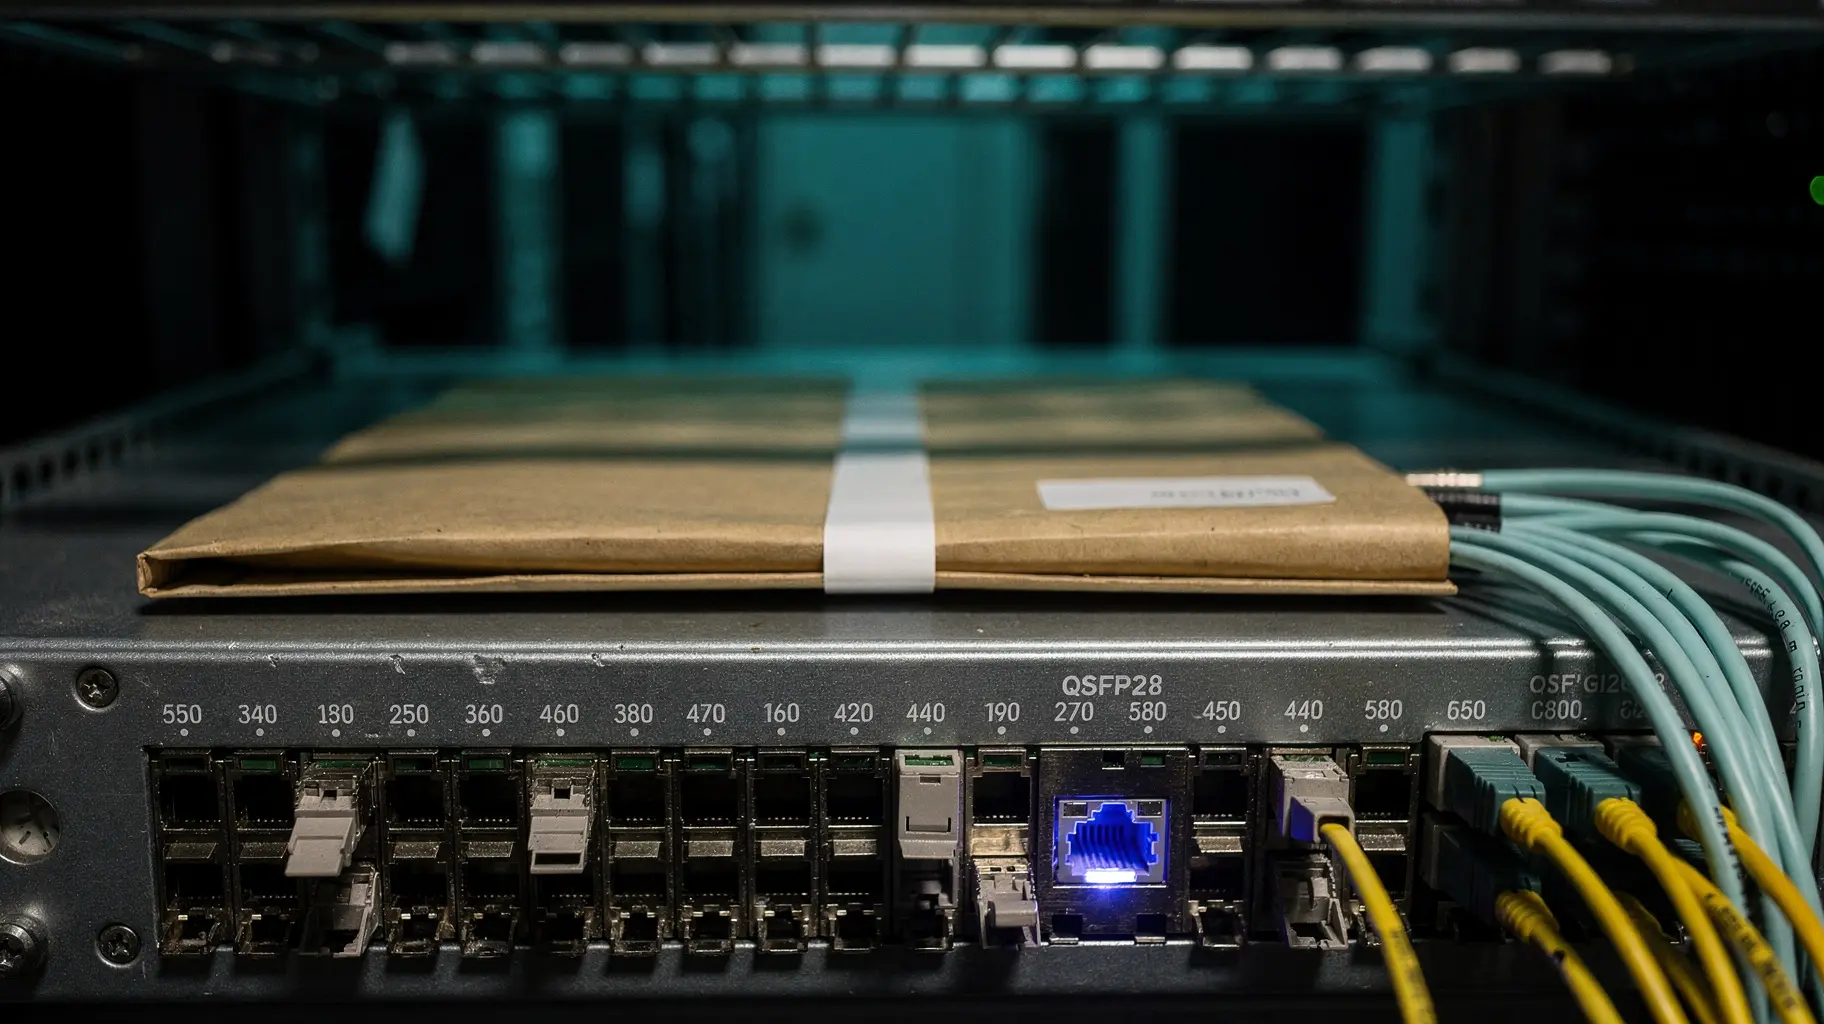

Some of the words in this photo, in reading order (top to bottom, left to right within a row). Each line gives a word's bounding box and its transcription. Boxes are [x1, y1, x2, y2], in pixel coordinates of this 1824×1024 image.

[1062, 674, 1163, 697] QSFP28
[162, 704, 202, 725] 550
[238, 704, 277, 725] 340
[317, 704, 354, 725] 180
[389, 704, 429, 725] 250
[465, 704, 504, 725] 360
[539, 704, 579, 724] 460
[613, 703, 653, 724] 380
[686, 703, 726, 724] 470
[764, 703, 800, 723] 160
[834, 703, 874, 723] 420
[906, 702, 946, 723] 440
[985, 702, 1020, 722] 190
[1054, 702, 1094, 722] 270
[1129, 701, 1167, 721] 580
[1202, 701, 1241, 721] 450
[1284, 700, 1324, 721] 440
[1364, 700, 1403, 720] 580
[1447, 700, 1486, 721] 650
